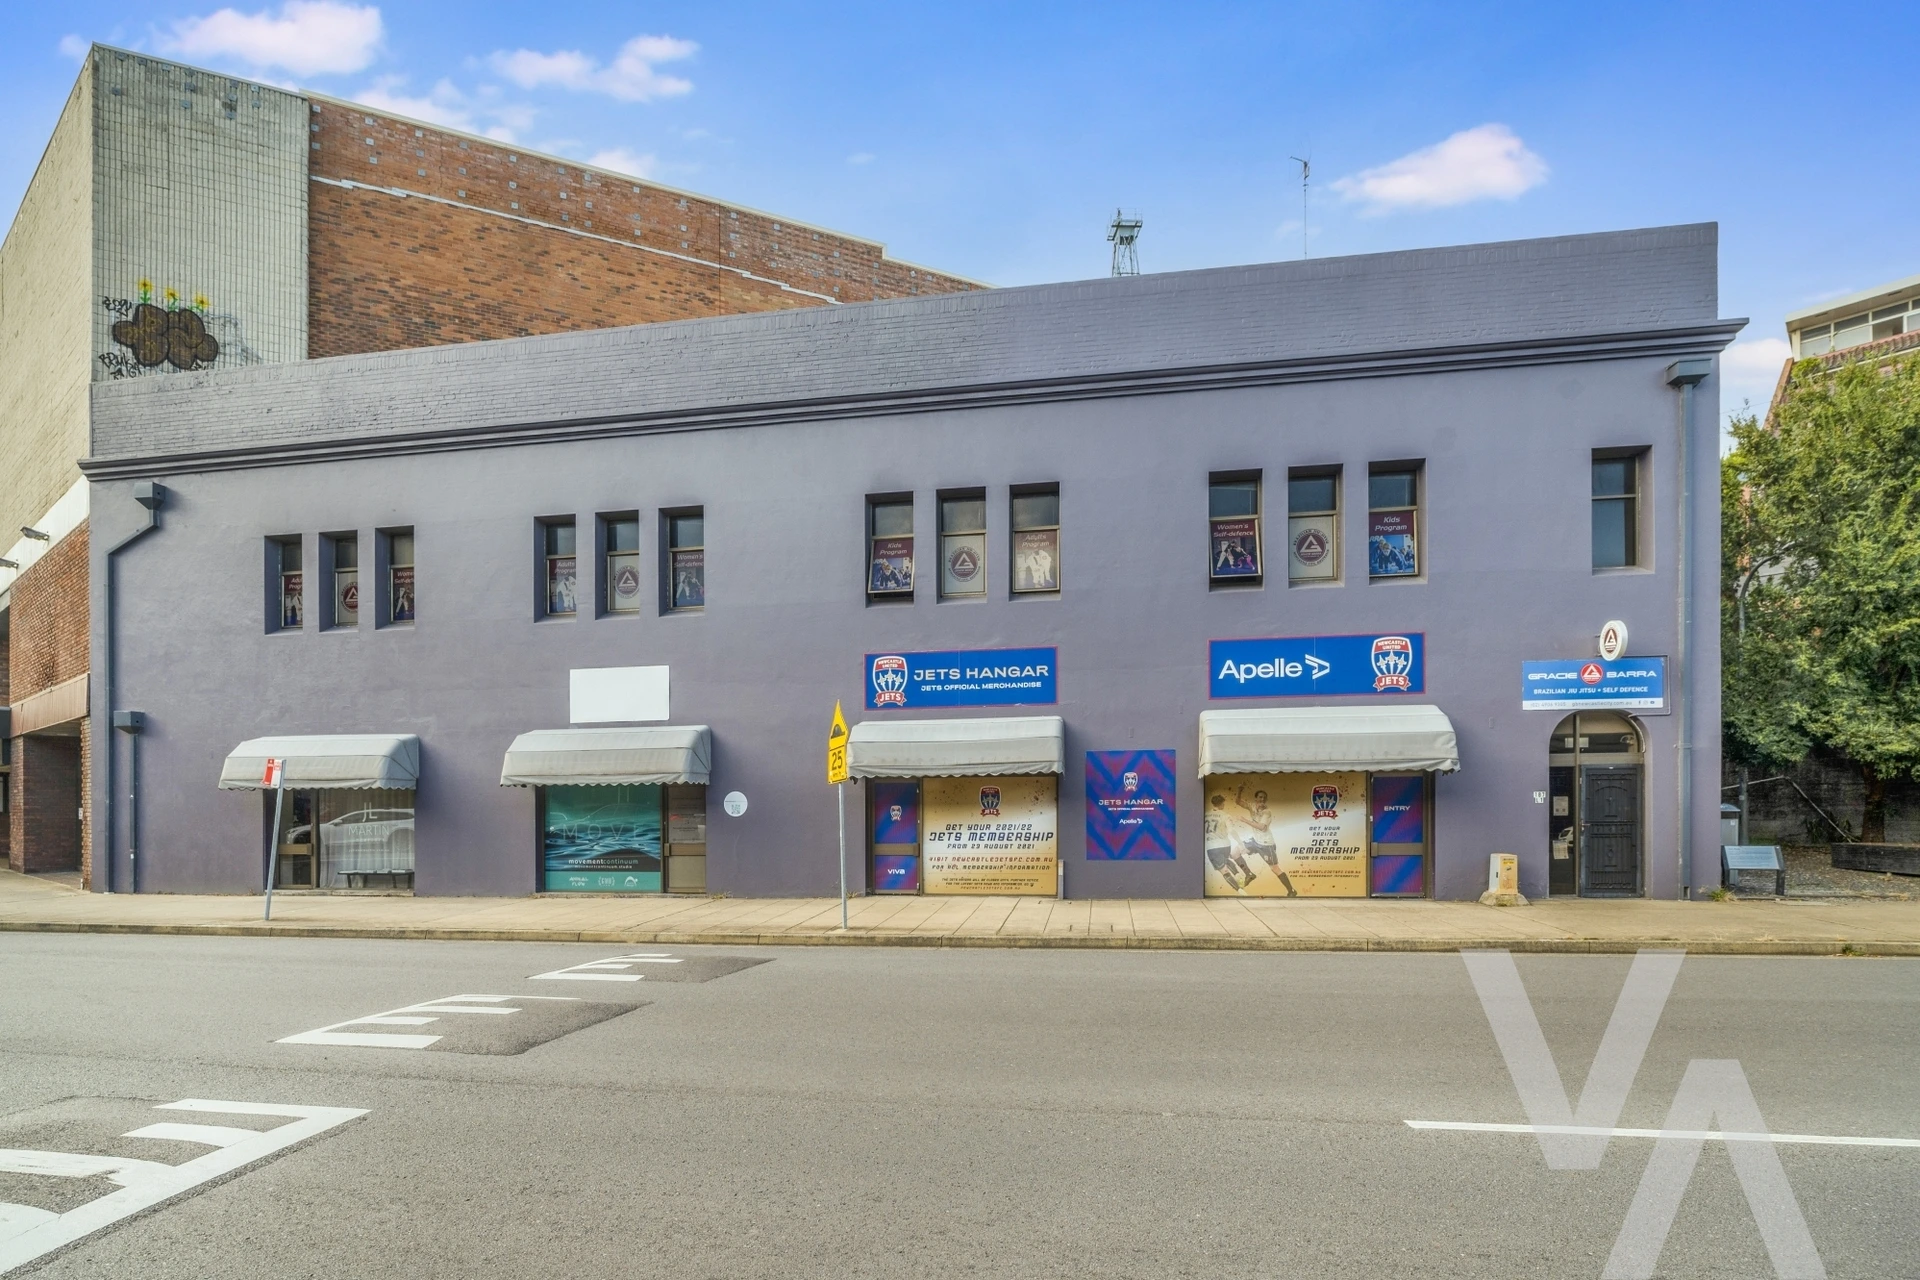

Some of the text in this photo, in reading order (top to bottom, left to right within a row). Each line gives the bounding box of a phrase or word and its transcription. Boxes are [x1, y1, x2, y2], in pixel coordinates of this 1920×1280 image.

[914, 666, 1049, 681] JETS HANGAR
[1218, 658, 1303, 684] Apelle
[1528, 672, 1578, 680] GRACIE
[982, 682, 1042, 690] MERCHANDISE
[1380, 677, 1405, 686] JETS
[880, 693, 901, 701] JETS
[832, 750, 843, 771] 25
[362, 802, 378, 823] JL
[349, 825, 390, 836] MARTIN
[929, 832, 1054, 842] JETS MEMBERSHIP
[1311, 839, 1339, 847] JETS
[1290, 847, 1361, 855] MEMBERSHIP
